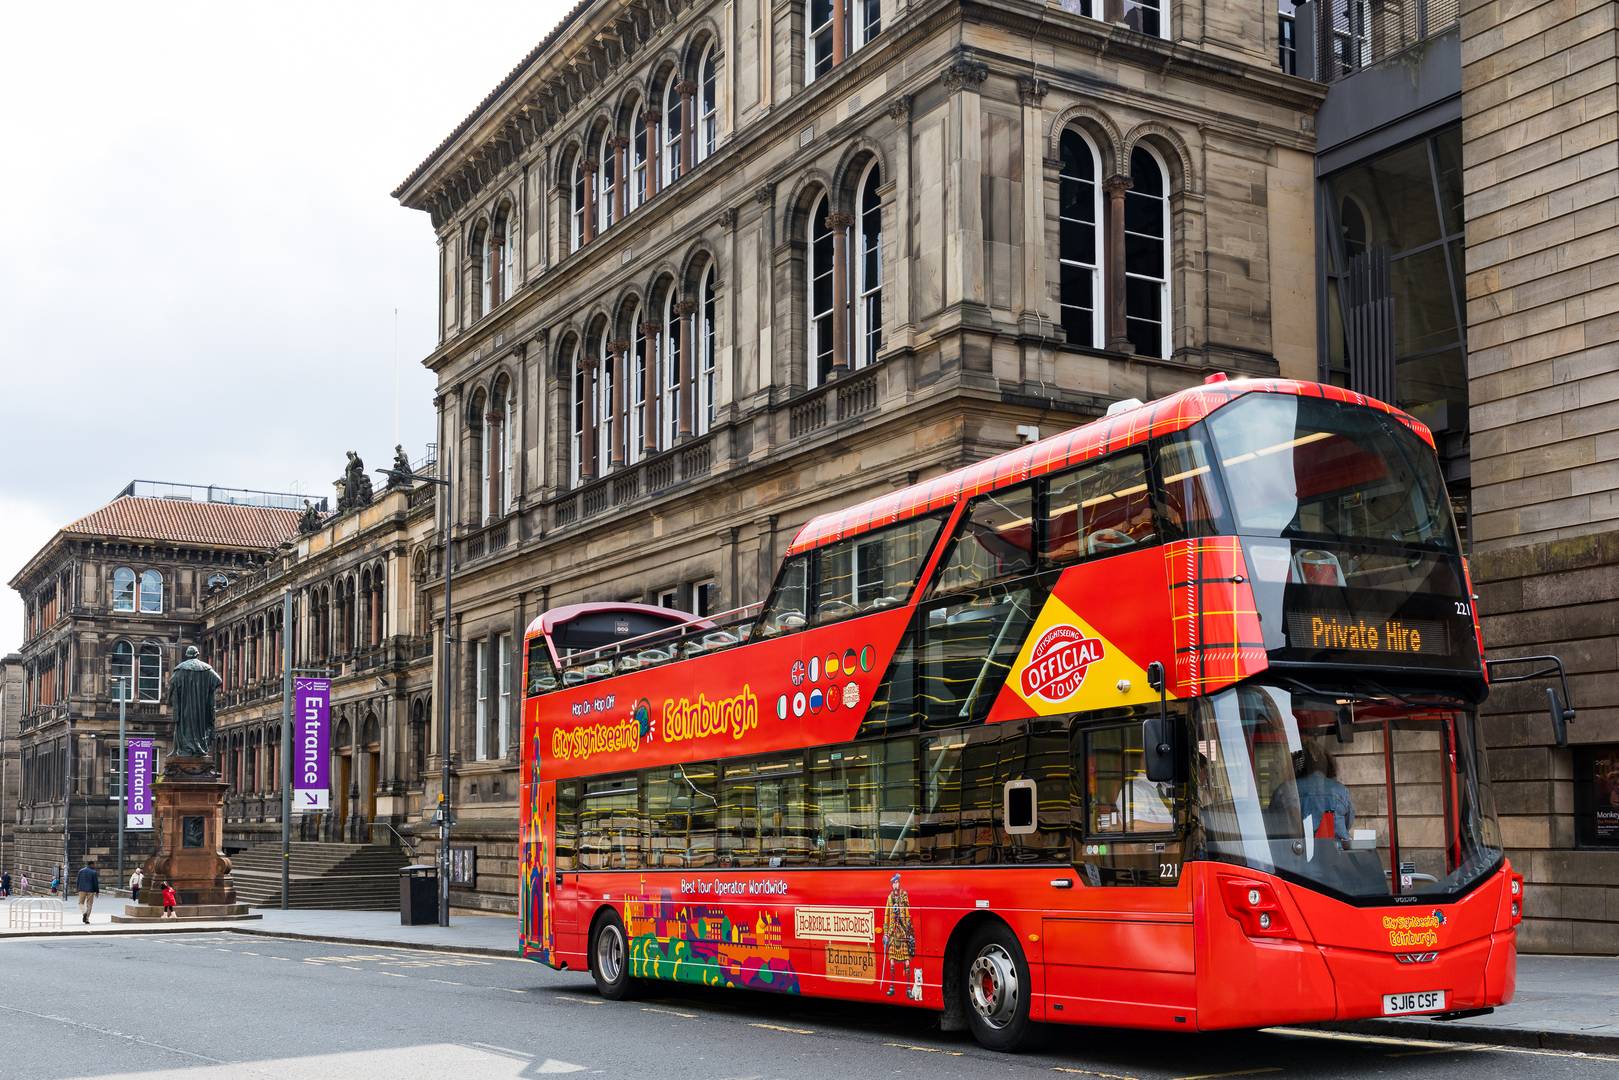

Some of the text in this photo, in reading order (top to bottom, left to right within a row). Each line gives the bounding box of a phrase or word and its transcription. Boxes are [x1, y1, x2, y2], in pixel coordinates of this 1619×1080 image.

[1454, 602, 1471, 616] 221
[1312, 617, 1421, 651] Private Hire
[1028, 641, 1100, 689] OFFICIAL
[1051, 671, 1083, 697] TOUR
[662, 683, 758, 743] Edinburgh
[304, 697, 323, 784] Entrance
[134, 751, 147, 811] Entrance
[1159, 863, 1178, 878] 221
[681, 878, 788, 896] Best Tour Operator Worldwide
[1389, 928, 1438, 947] Edinburgh
[827, 947, 874, 971] Edinburgh
[1390, 992, 1438, 1011] SJ16 CSF
